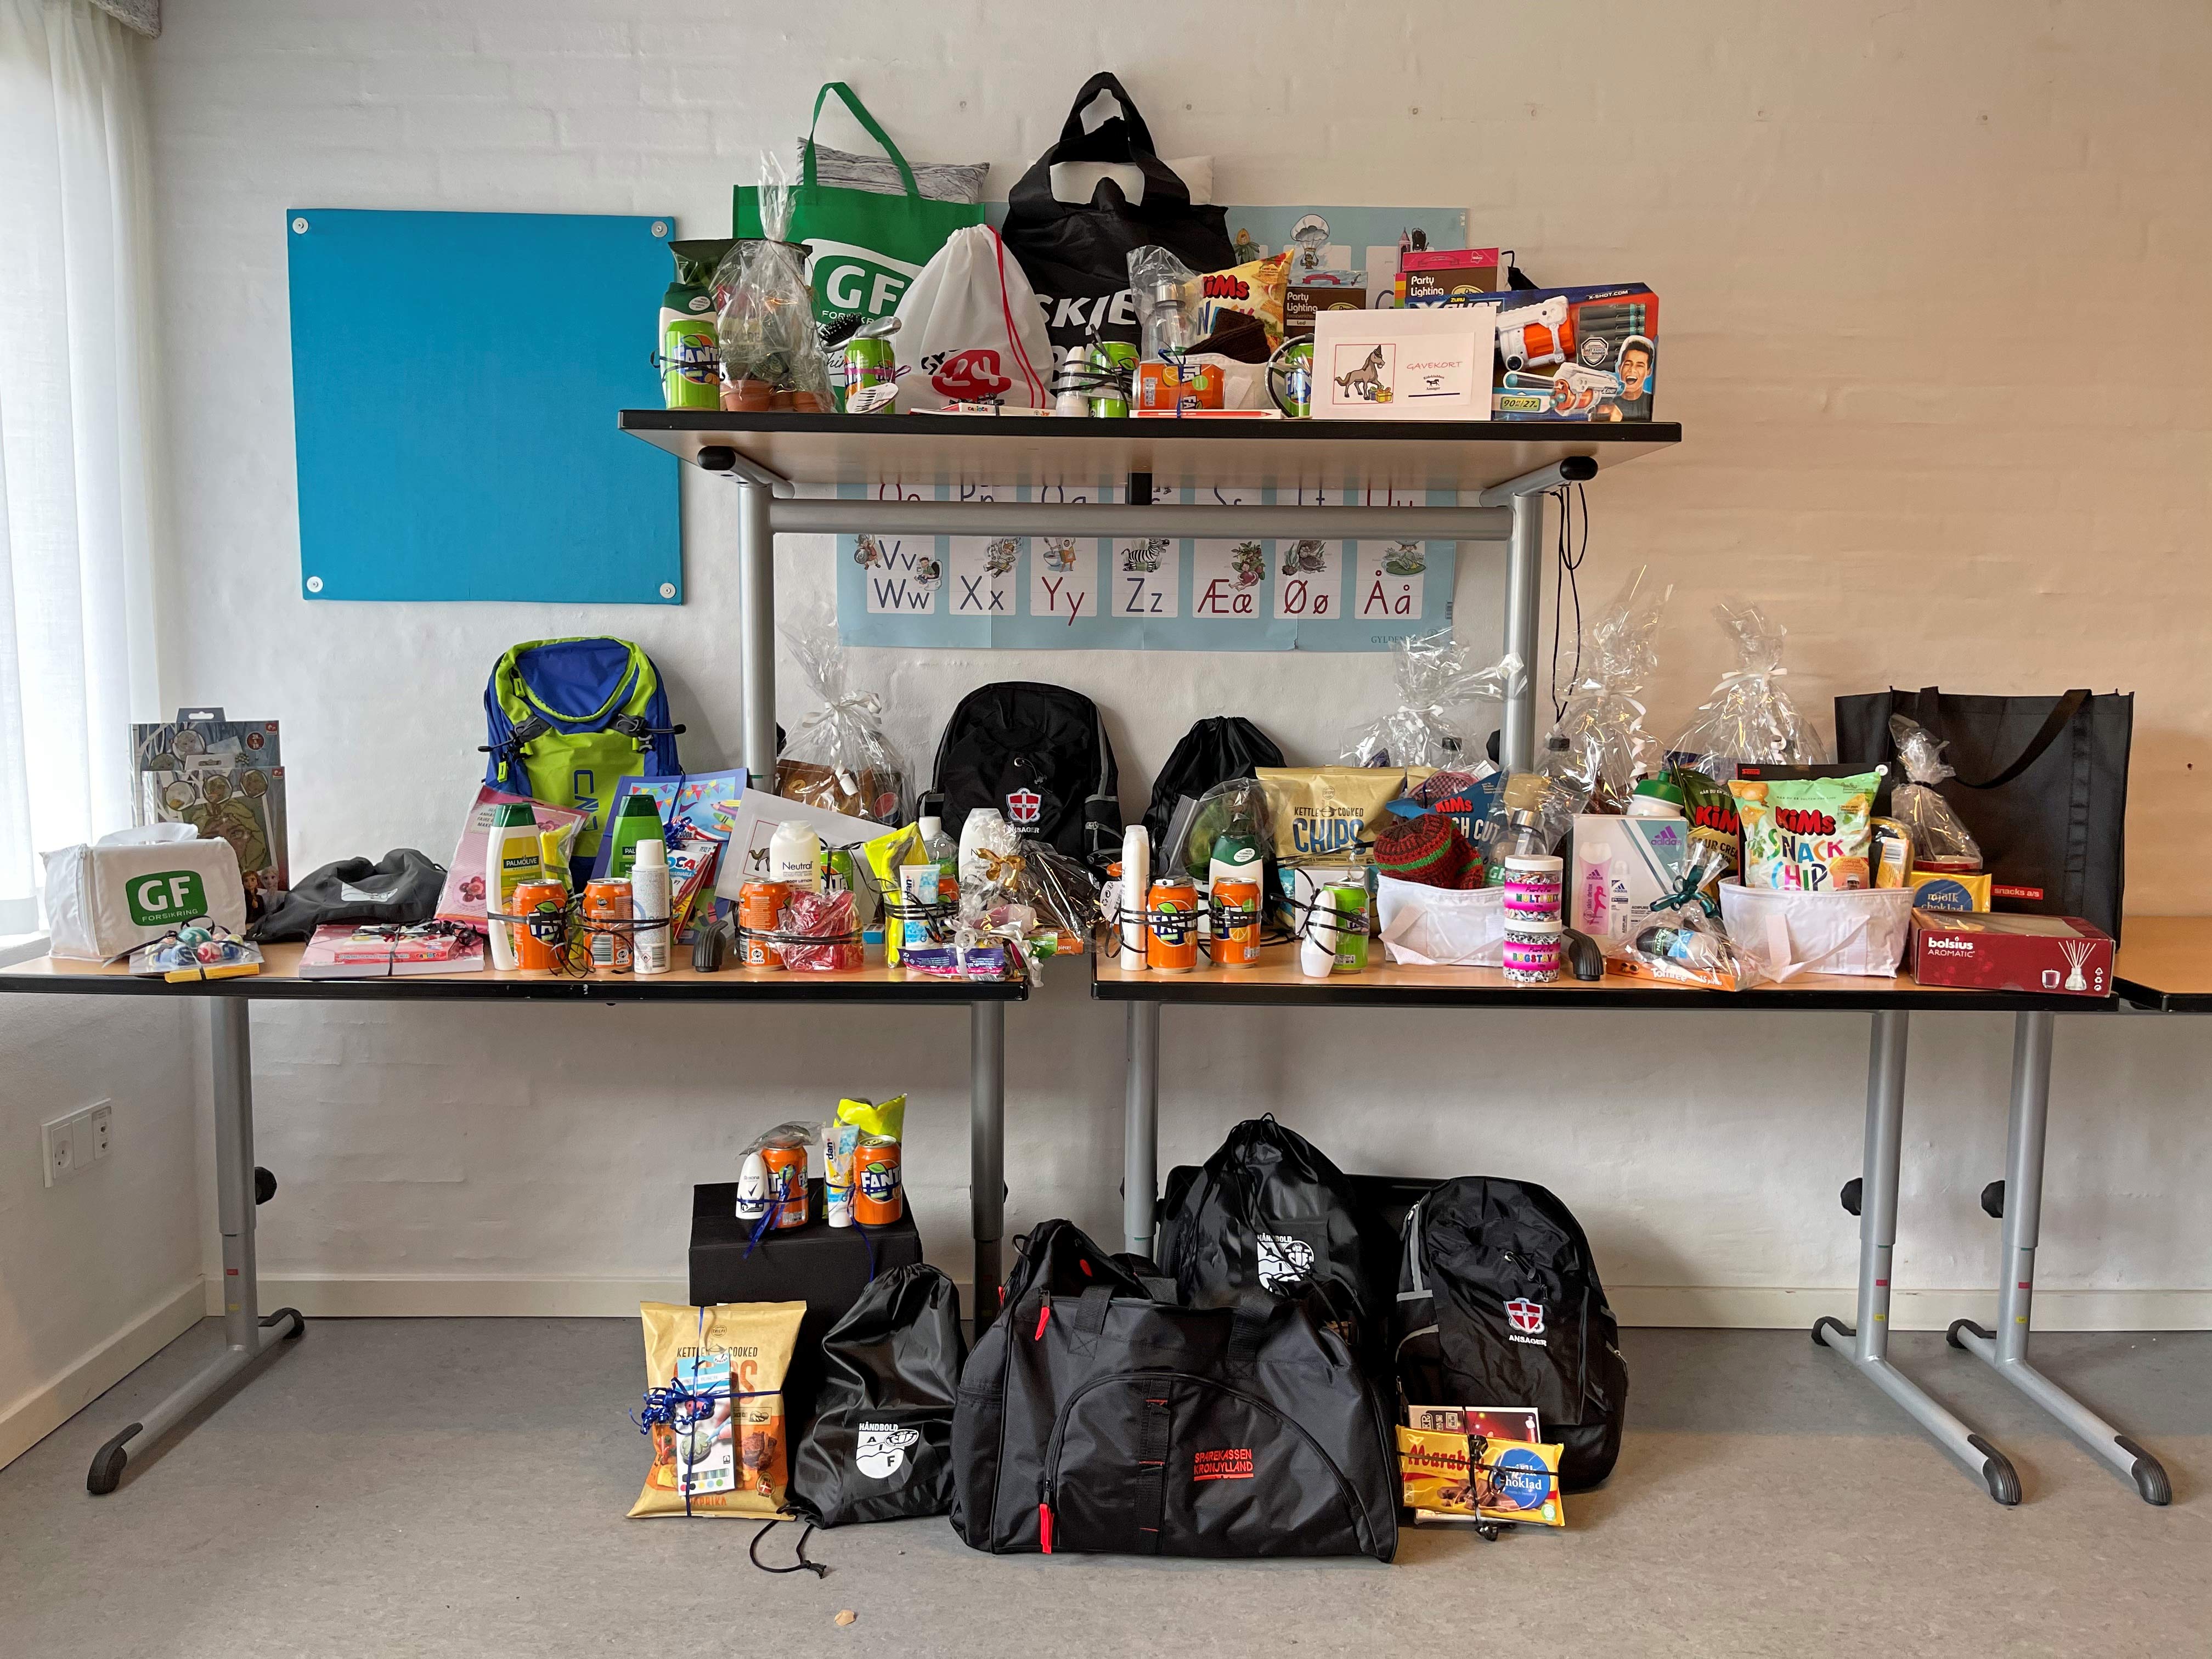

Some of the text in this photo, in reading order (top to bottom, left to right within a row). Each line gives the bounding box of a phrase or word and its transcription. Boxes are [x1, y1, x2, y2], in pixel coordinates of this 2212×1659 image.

[1411, 276, 1435, 286] Party
[827, 265, 905, 315] GF
[1410, 286, 1444, 297] Lighting
[1589, 290, 1628, 300] X-SHOT.COM
[1287, 292, 1309, 302] Party
[1286, 303, 1318, 314] Lighting
[1407, 362, 1463, 370] GAVEKORT
[1294, 806, 1364, 817] KETTLE COOKED
[1695, 805, 1739, 834] KiM
[1775, 806, 1836, 836] KiMs
[1293, 817, 1366, 855] CHIPS
[1474, 819, 1500, 844] CUT
[1767, 828, 1846, 863] SNACK
[506, 857, 537, 867] PALMOLIVE
[782, 861, 812, 870] Neutral
[1771, 861, 1828, 891] CHIP
[138, 876, 190, 911] GF
[1516, 893, 1559, 902] MULTI MIX
[1994, 888, 2025, 896] snacks
[1927, 892, 1959, 904] mjölk
[142, 909, 198, 922] FORSIKRING
[1928, 936, 1974, 950] bolsius
[1513, 952, 1553, 963] BOGSTAV
[1927, 949, 1975, 958] AROMATIC
[1257, 1232, 1293, 1242] HÅNBOLD
[1509, 1334, 1547, 1347] ANSAGER
[729, 1347, 758, 1357] COOKED
[859, 1421, 899, 1431] HÅNDBOLD
[1195, 1448, 1252, 1463] SPAREKASSEN
[1194, 1461, 1254, 1475] KRONJYLLAND
[1503, 1478, 1542, 1491] hoklad
